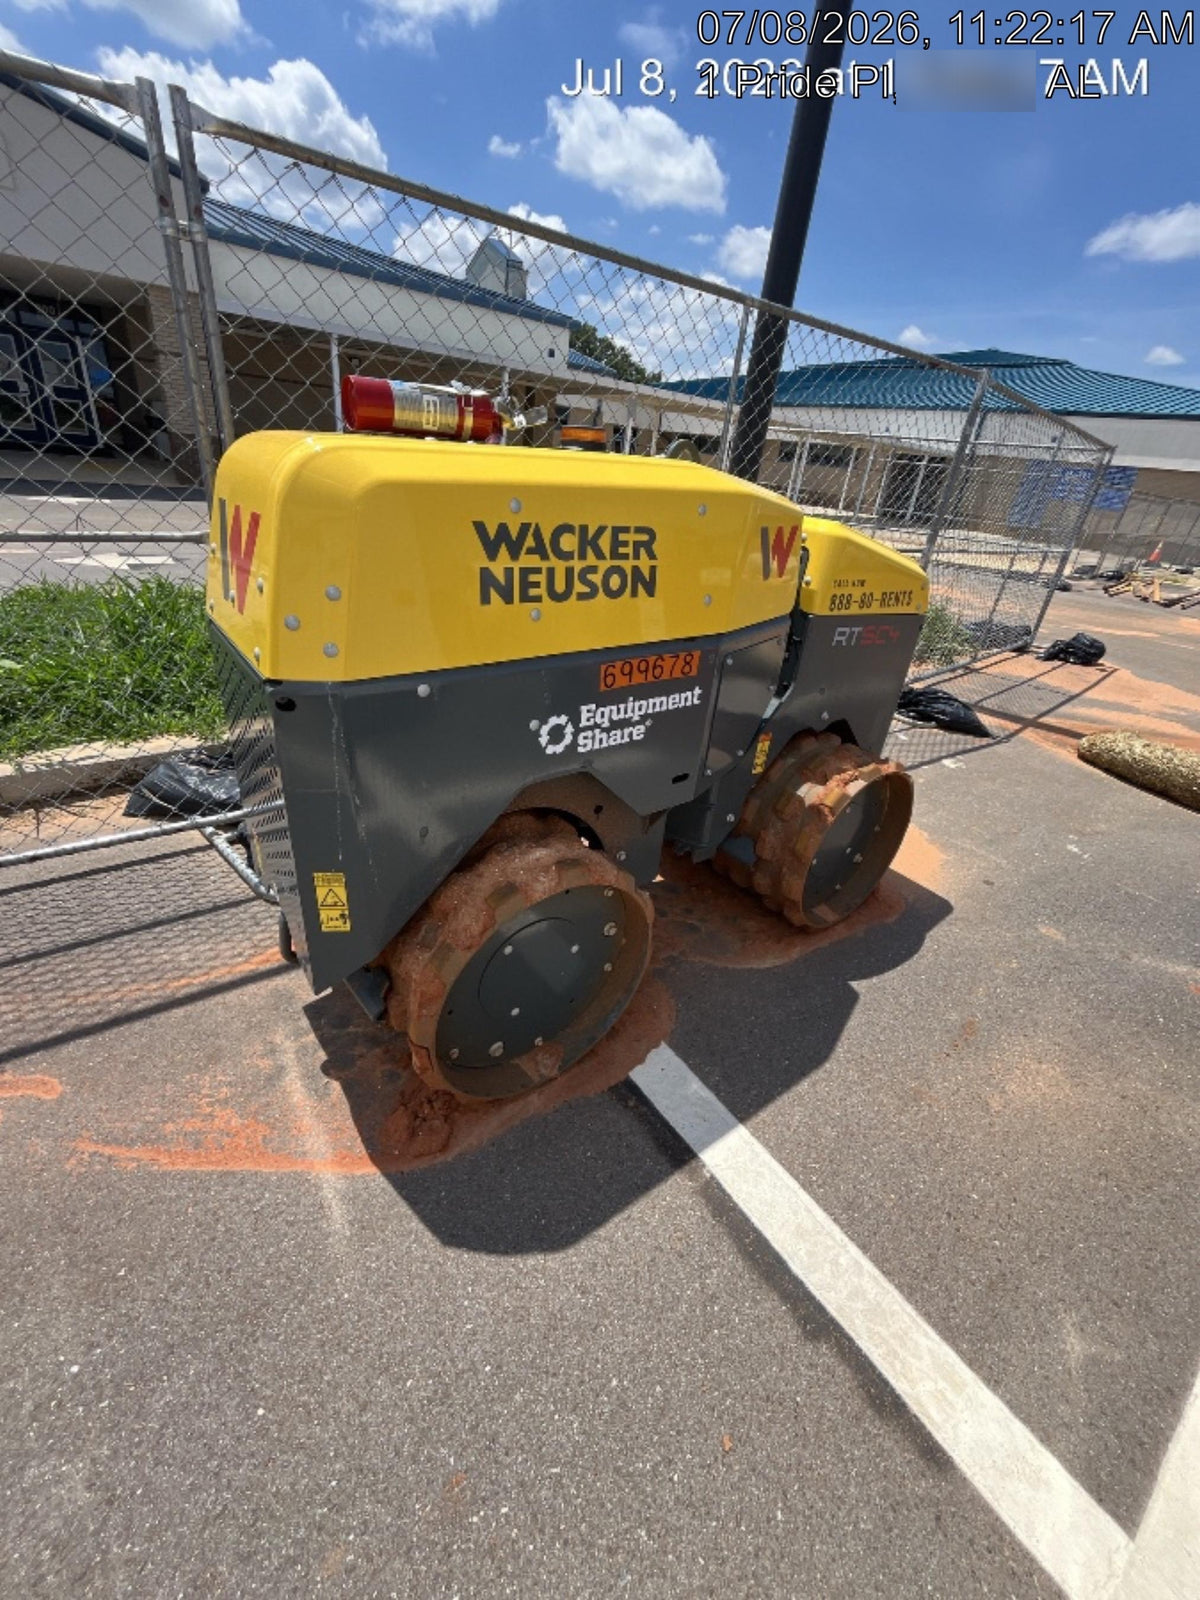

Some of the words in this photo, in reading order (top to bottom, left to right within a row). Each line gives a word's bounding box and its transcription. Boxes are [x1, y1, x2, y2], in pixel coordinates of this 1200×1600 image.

[472, 520, 658, 562] WACKER
[479, 565, 658, 605] NEUSON
[829, 590, 914, 612] 888-80-RENTS
[603, 652, 695, 689] 699678
[579, 686, 703, 728] Equipment
